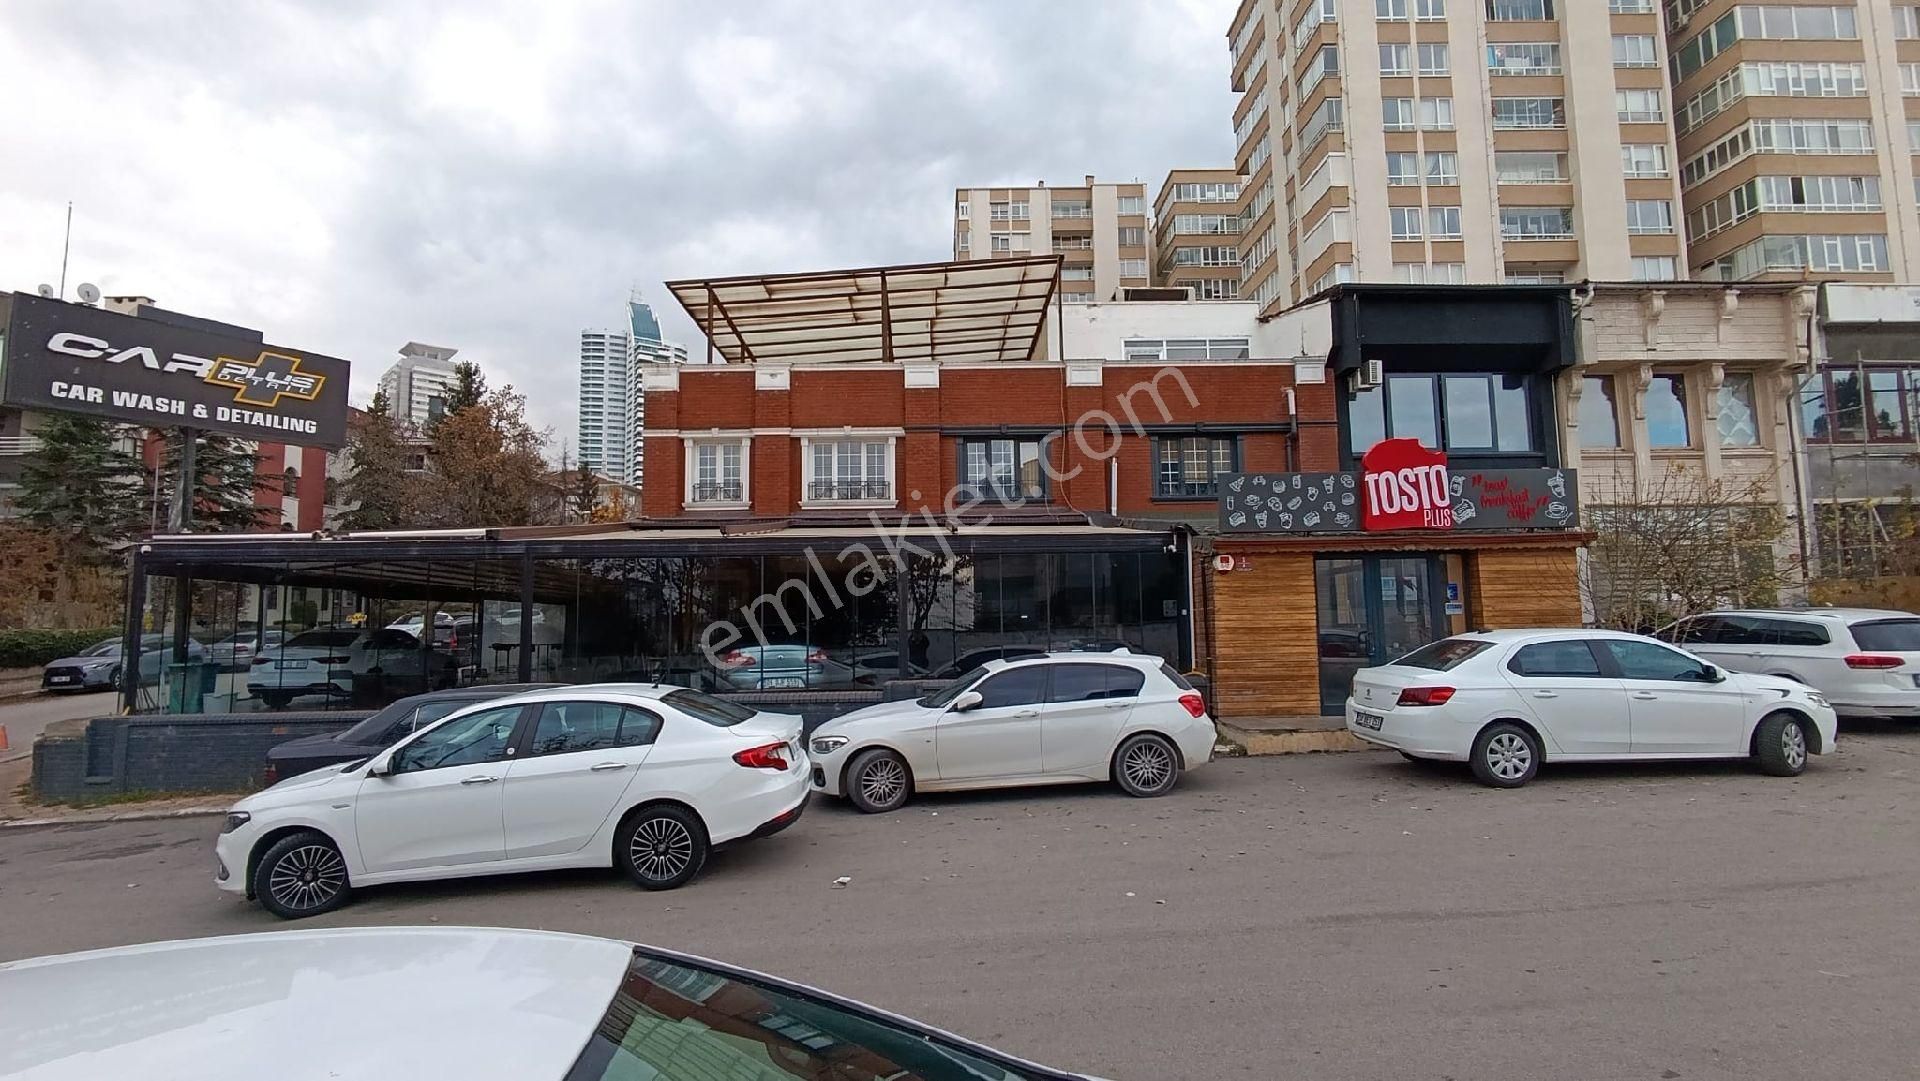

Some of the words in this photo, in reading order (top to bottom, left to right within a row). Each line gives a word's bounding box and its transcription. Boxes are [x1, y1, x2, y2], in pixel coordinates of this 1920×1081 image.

[221, 363, 315, 388] PLUS
[52, 381, 103, 403] CAR
[113, 391, 185, 415] WASH
[193, 403, 209, 419] &
[216, 406, 317, 434] DETAILING
[1365, 465, 1451, 516] TOSTO
[1423, 509, 1452, 527] PLUS
